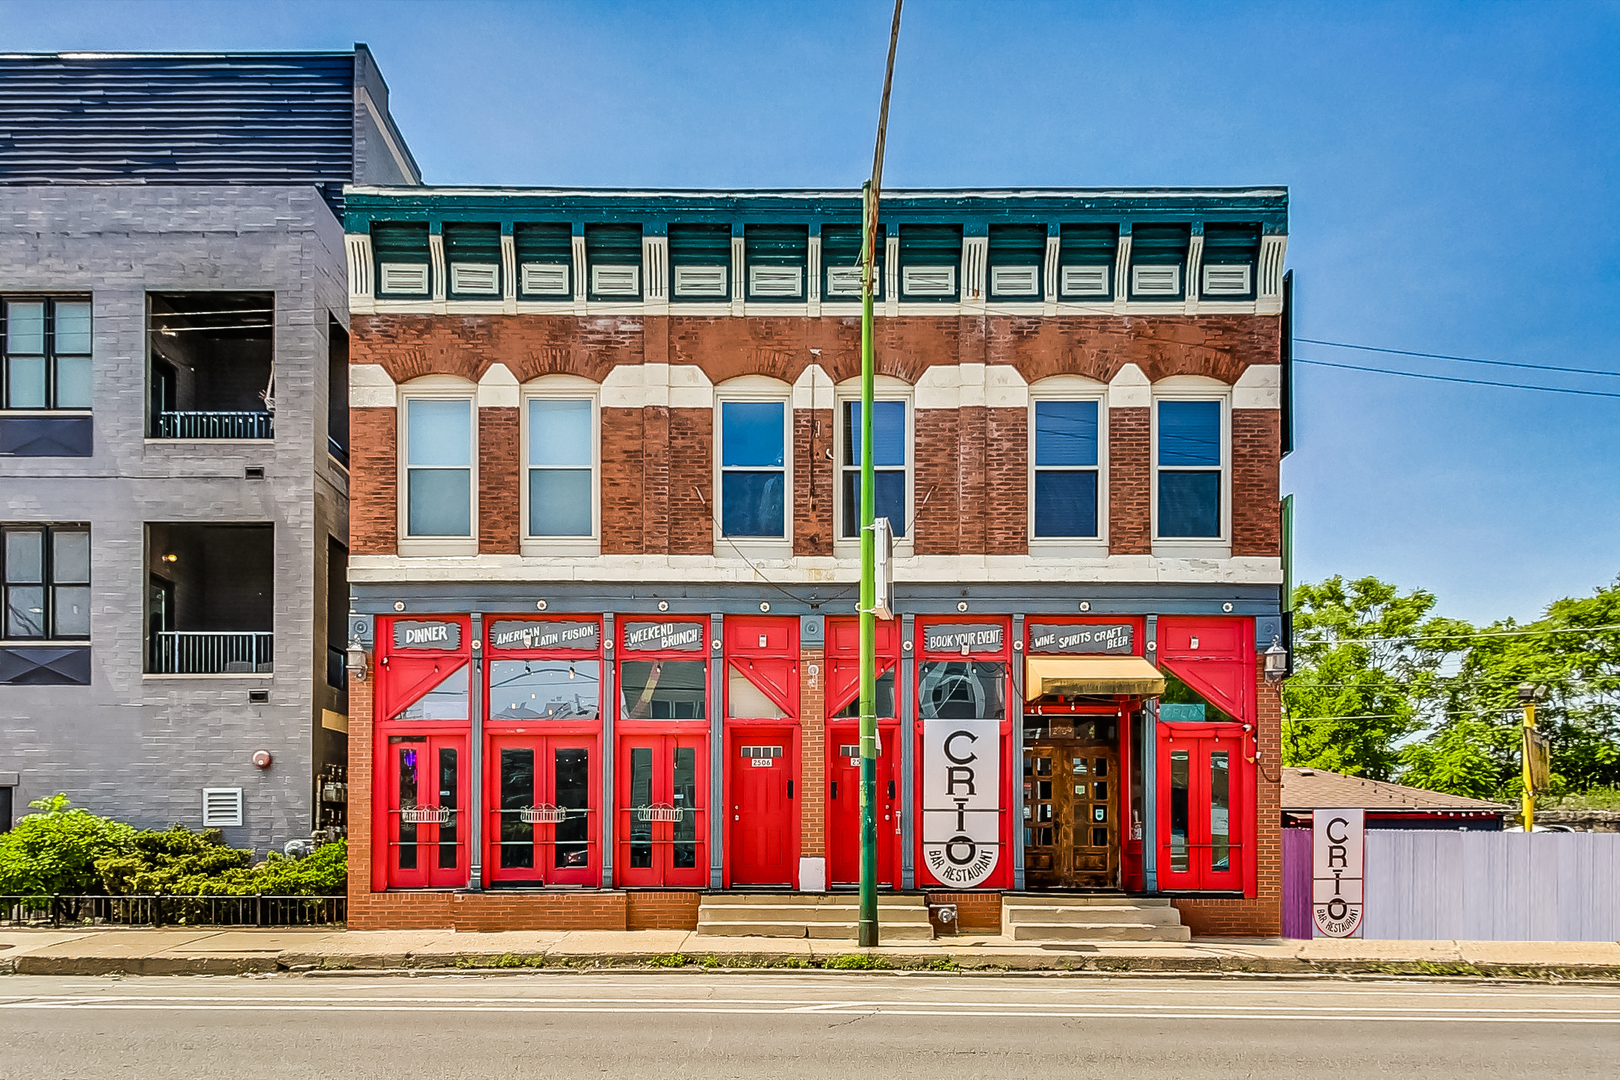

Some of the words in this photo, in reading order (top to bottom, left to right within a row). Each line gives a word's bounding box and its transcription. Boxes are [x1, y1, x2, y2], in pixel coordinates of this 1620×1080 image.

[406, 626, 448, 644] DINNER
[496, 626, 540, 645] AMERICAN
[534, 633, 558, 647] LATIN
[562, 625, 594, 641] FUSION
[630, 623, 674, 644] WEEKEND
[661, 628, 698, 648] BRUNCH
[930, 634, 953, 649] BOOK
[954, 632, 976, 647] YOUR
[977, 629, 1001, 644] EVENT
[1034, 633, 1056, 648] WINE
[1058, 631, 1091, 648] SPIRITS
[1094, 626, 1123, 642] CRAFT
[1106, 636, 1128, 650] BEER
[753, 758, 771, 766] 2506
[852, 758, 860, 766] 25
[929, 850, 945, 870] BAR
[942, 850, 993, 882] RESTAURANT
[1317, 909, 1327, 924] BAR
[1325, 908, 1359, 932] RESTAURANT
